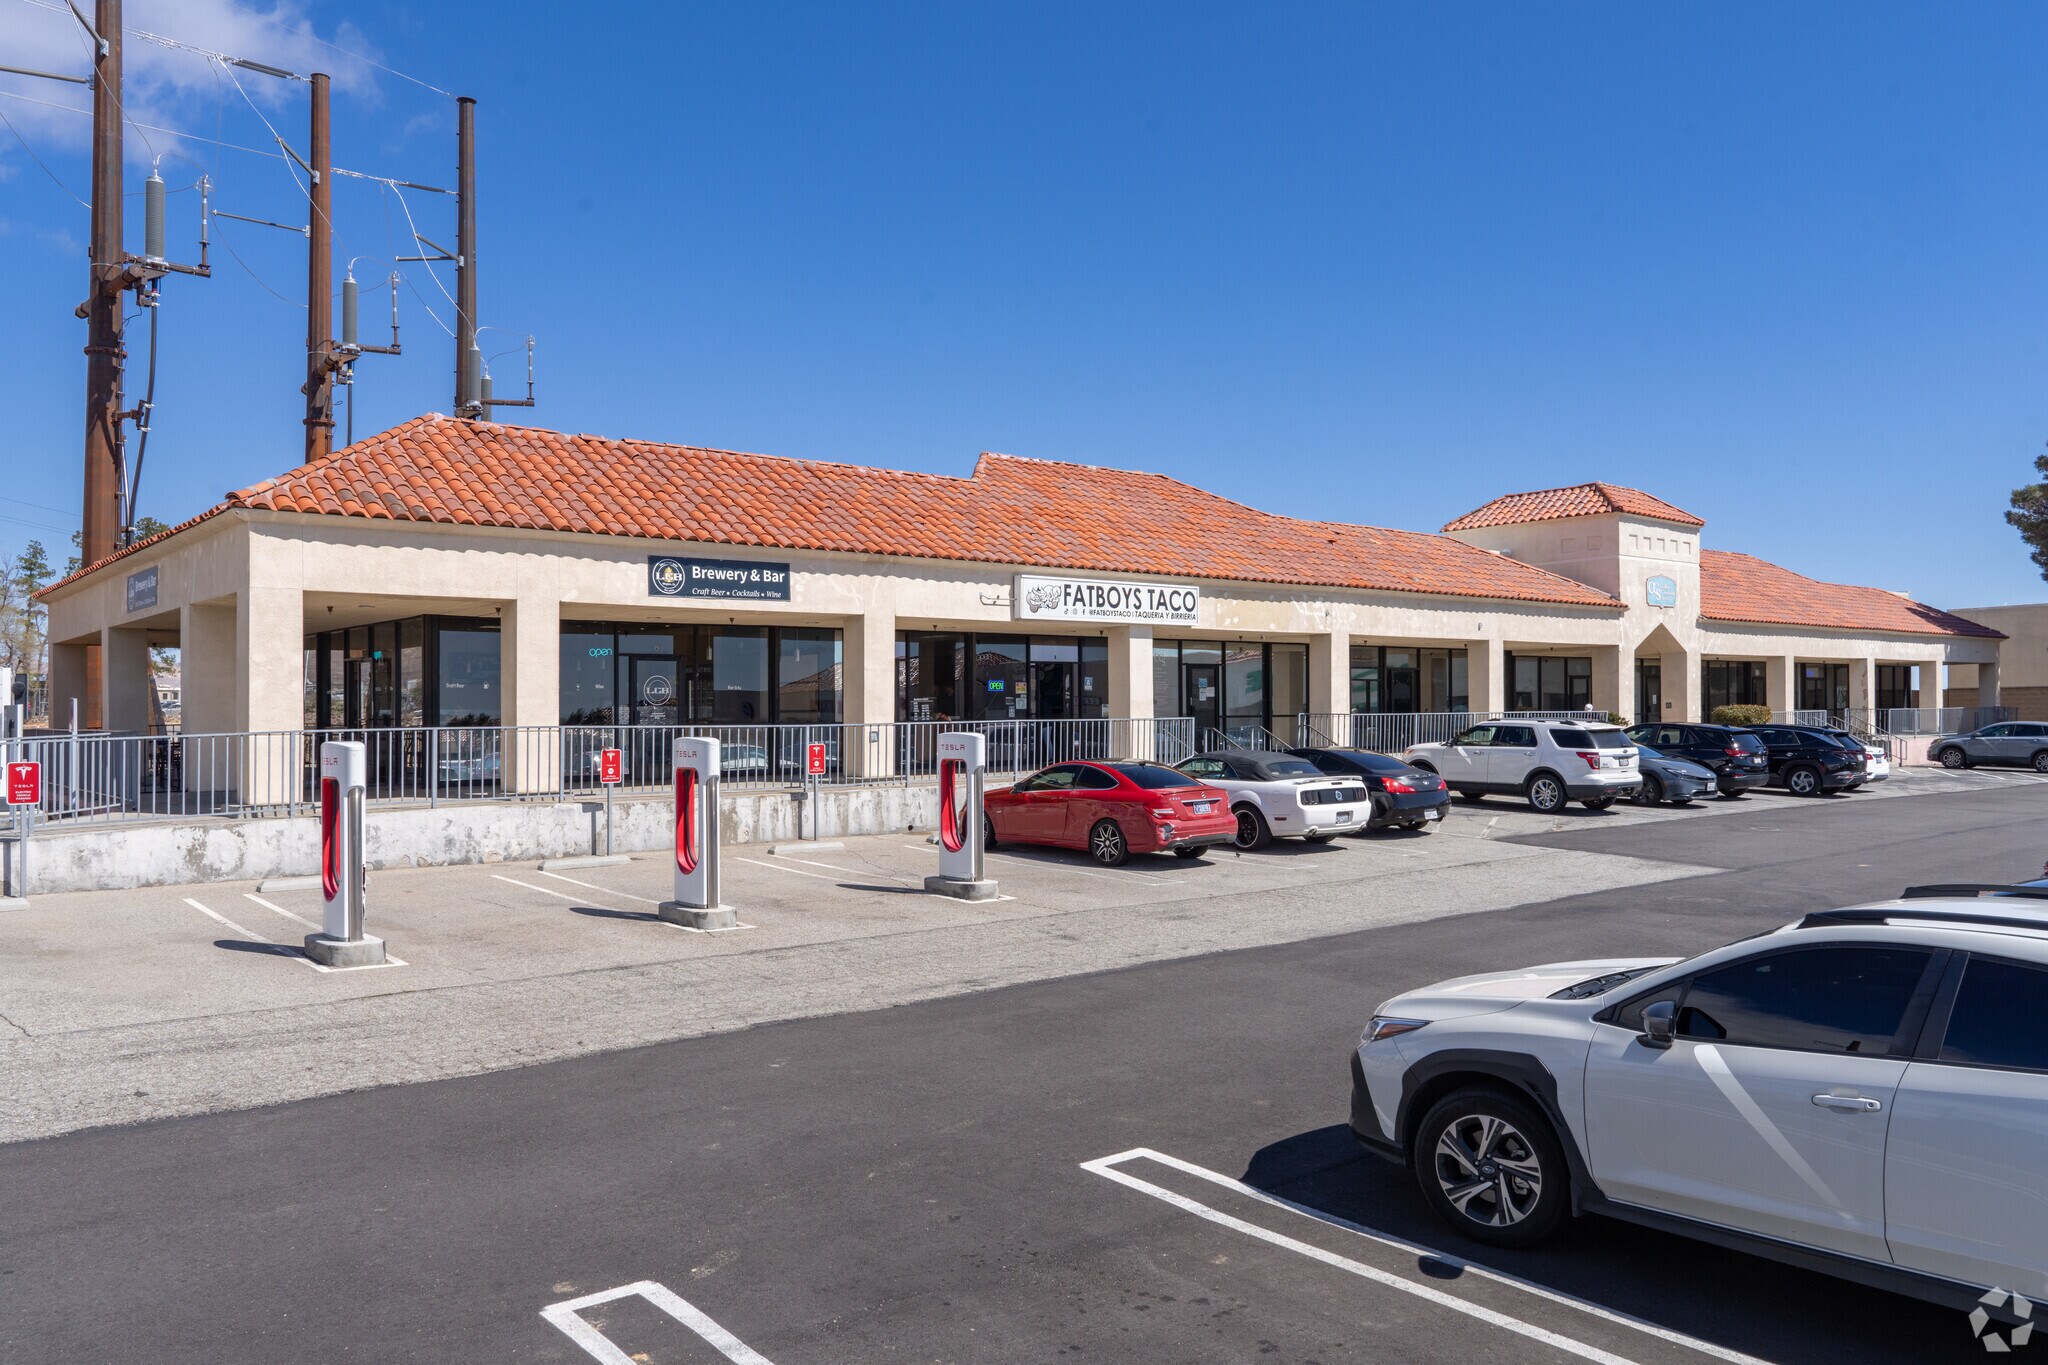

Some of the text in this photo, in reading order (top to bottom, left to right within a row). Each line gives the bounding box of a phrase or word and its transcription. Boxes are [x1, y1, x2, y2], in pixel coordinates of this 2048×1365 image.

[692, 566, 785, 584] Brewery & Bar
[692, 588, 710, 596] Craft
[711, 588, 726, 596] Beer
[732, 590, 760, 598] Cocktails
[1064, 584, 1196, 612] FATBOYS TACO
[1089, 609, 1131, 618] @FATBOYSTACO
[1135, 611, 1165, 619] TAQUERIA
[1171, 612, 1196, 620] BIRRIERIA
[589, 648, 612, 658] open
[989, 682, 1003, 690] OPEN
[941, 743, 966, 751] TESLA
[676, 750, 697, 758] TESLA
